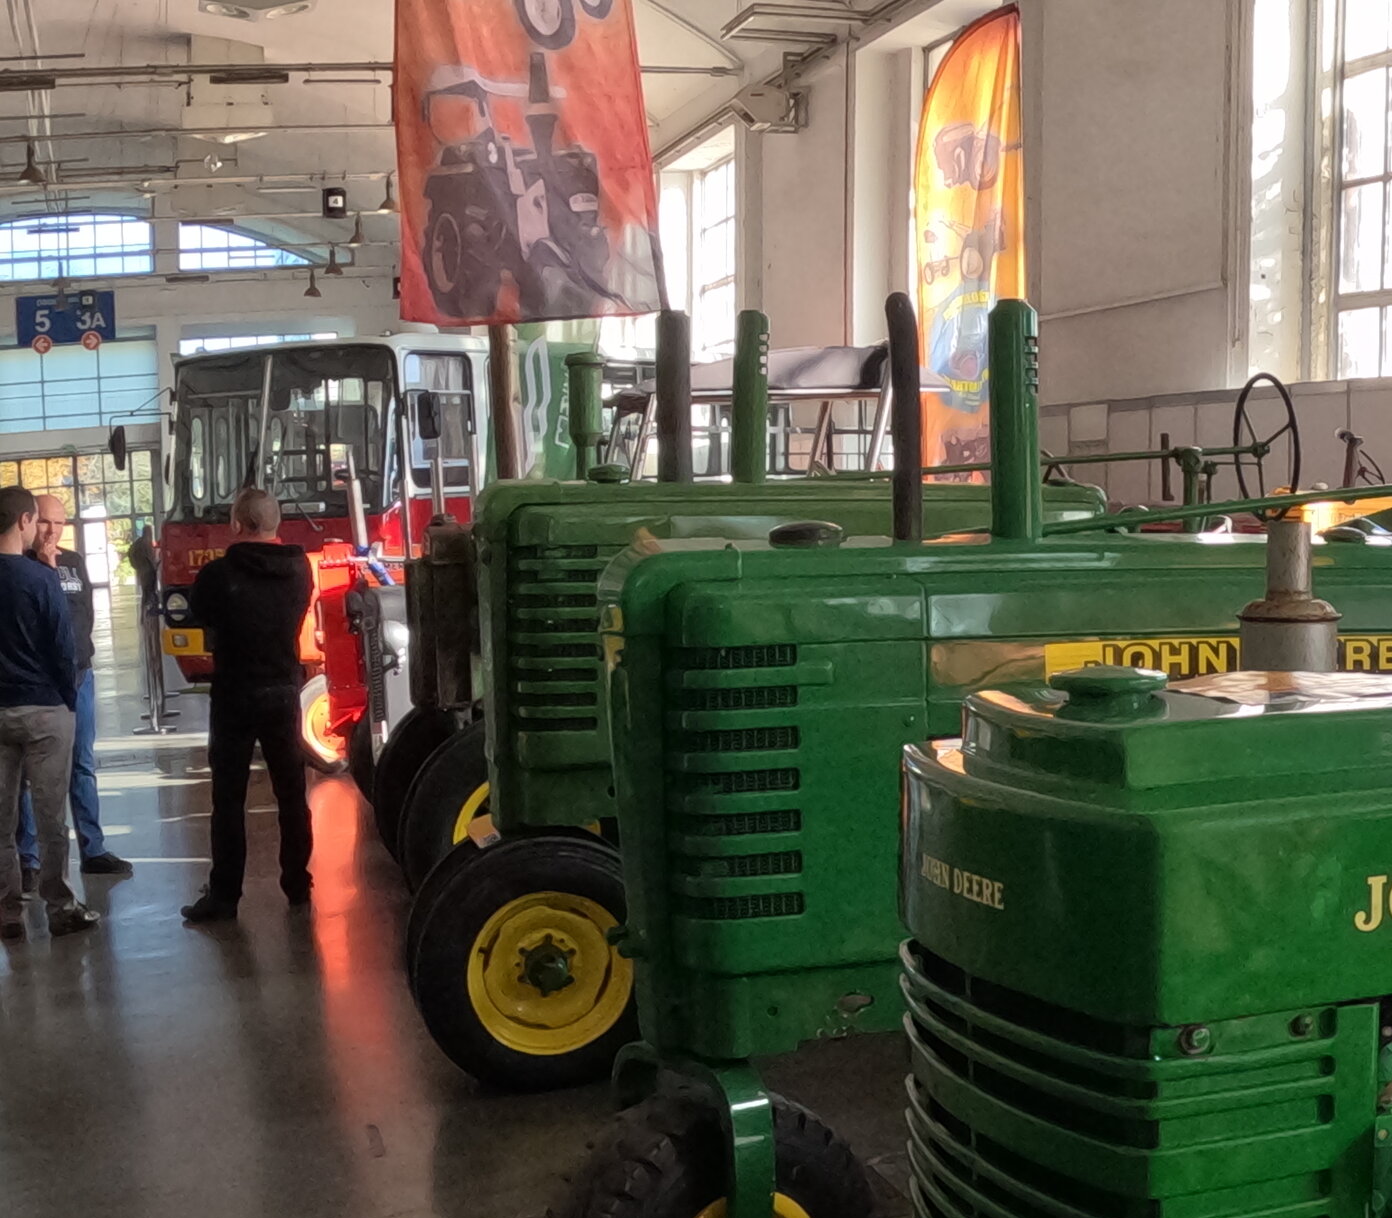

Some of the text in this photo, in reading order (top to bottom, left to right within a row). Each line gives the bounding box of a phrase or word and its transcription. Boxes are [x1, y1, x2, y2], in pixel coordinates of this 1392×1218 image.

[34, 309, 52, 333] 5
[75, 309, 107, 331] 3A
[921, 852, 1005, 910] JOHN DEERE
